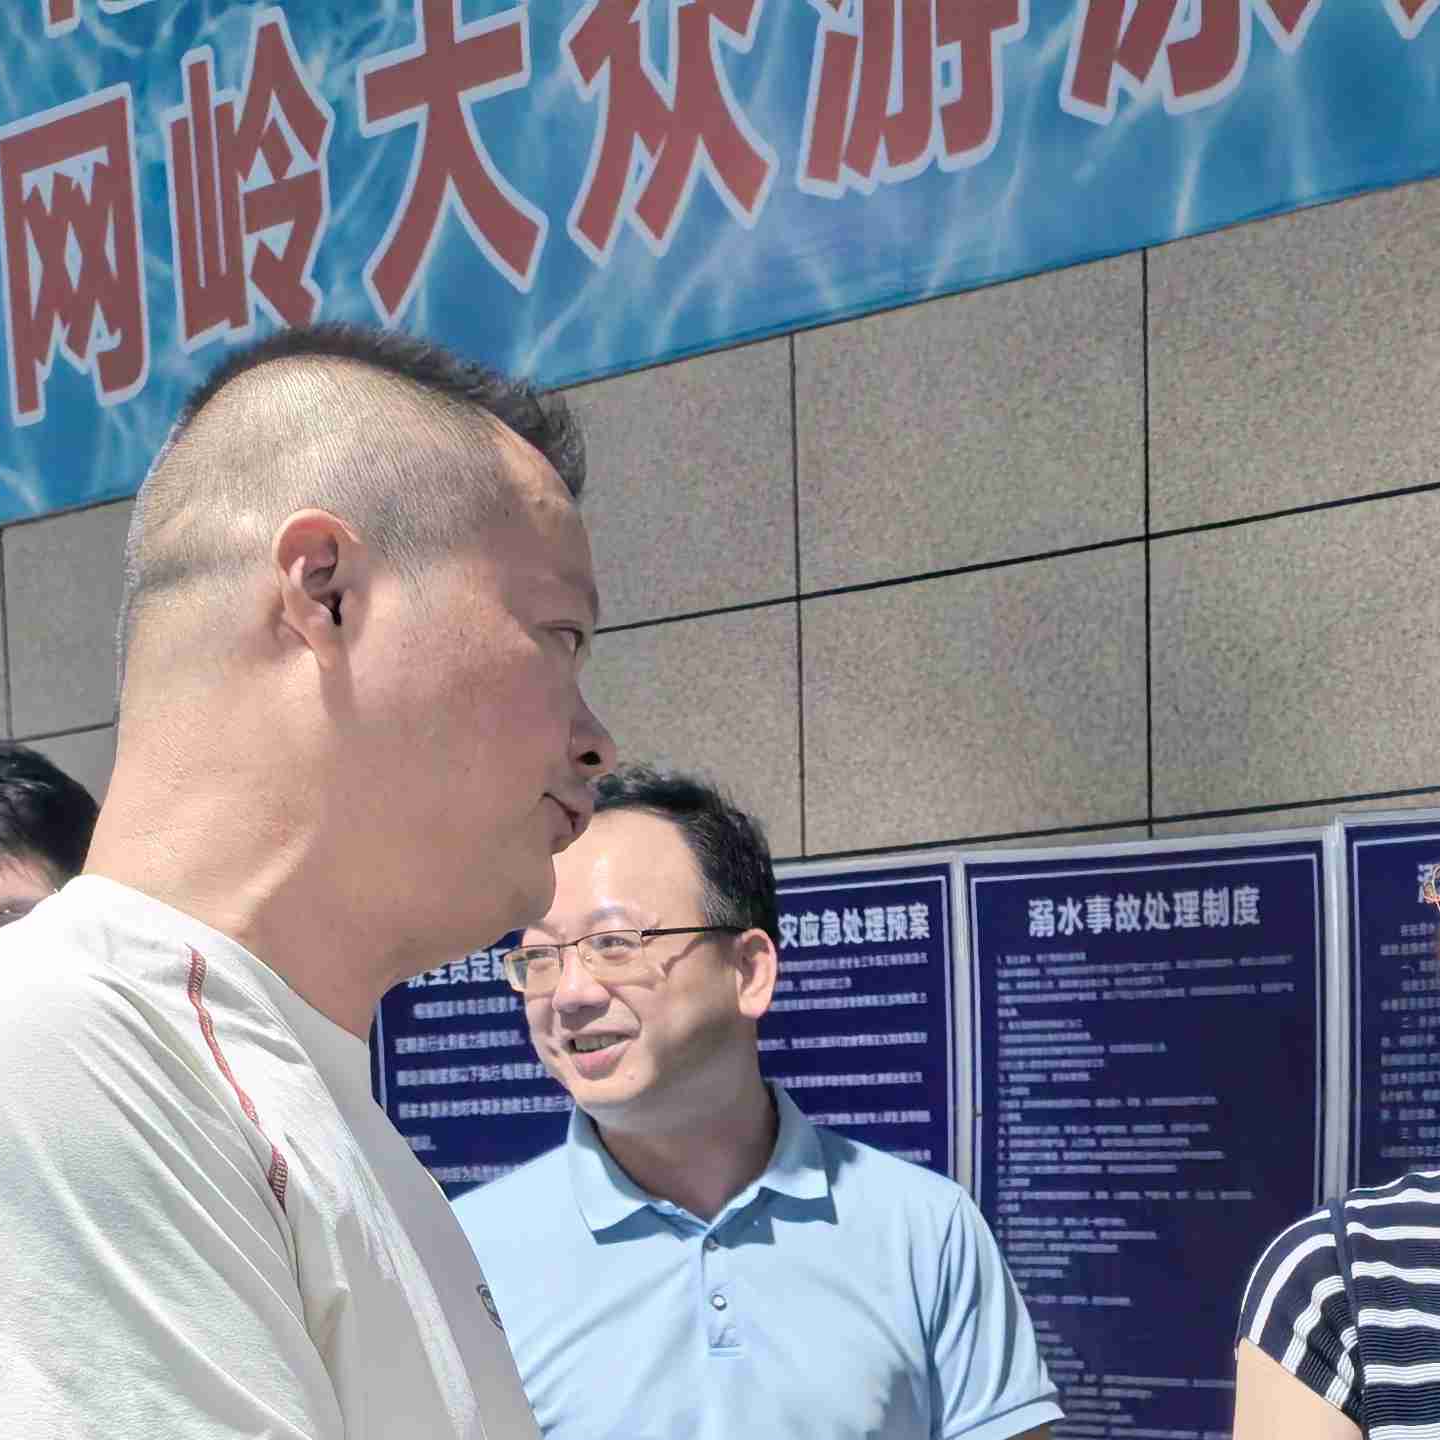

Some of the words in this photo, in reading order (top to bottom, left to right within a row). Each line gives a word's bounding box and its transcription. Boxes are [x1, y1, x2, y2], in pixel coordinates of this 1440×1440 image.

[777, 902, 931, 949] 灾应急处理预案
[1027, 886, 1261, 938] 溺水事故处理制度
